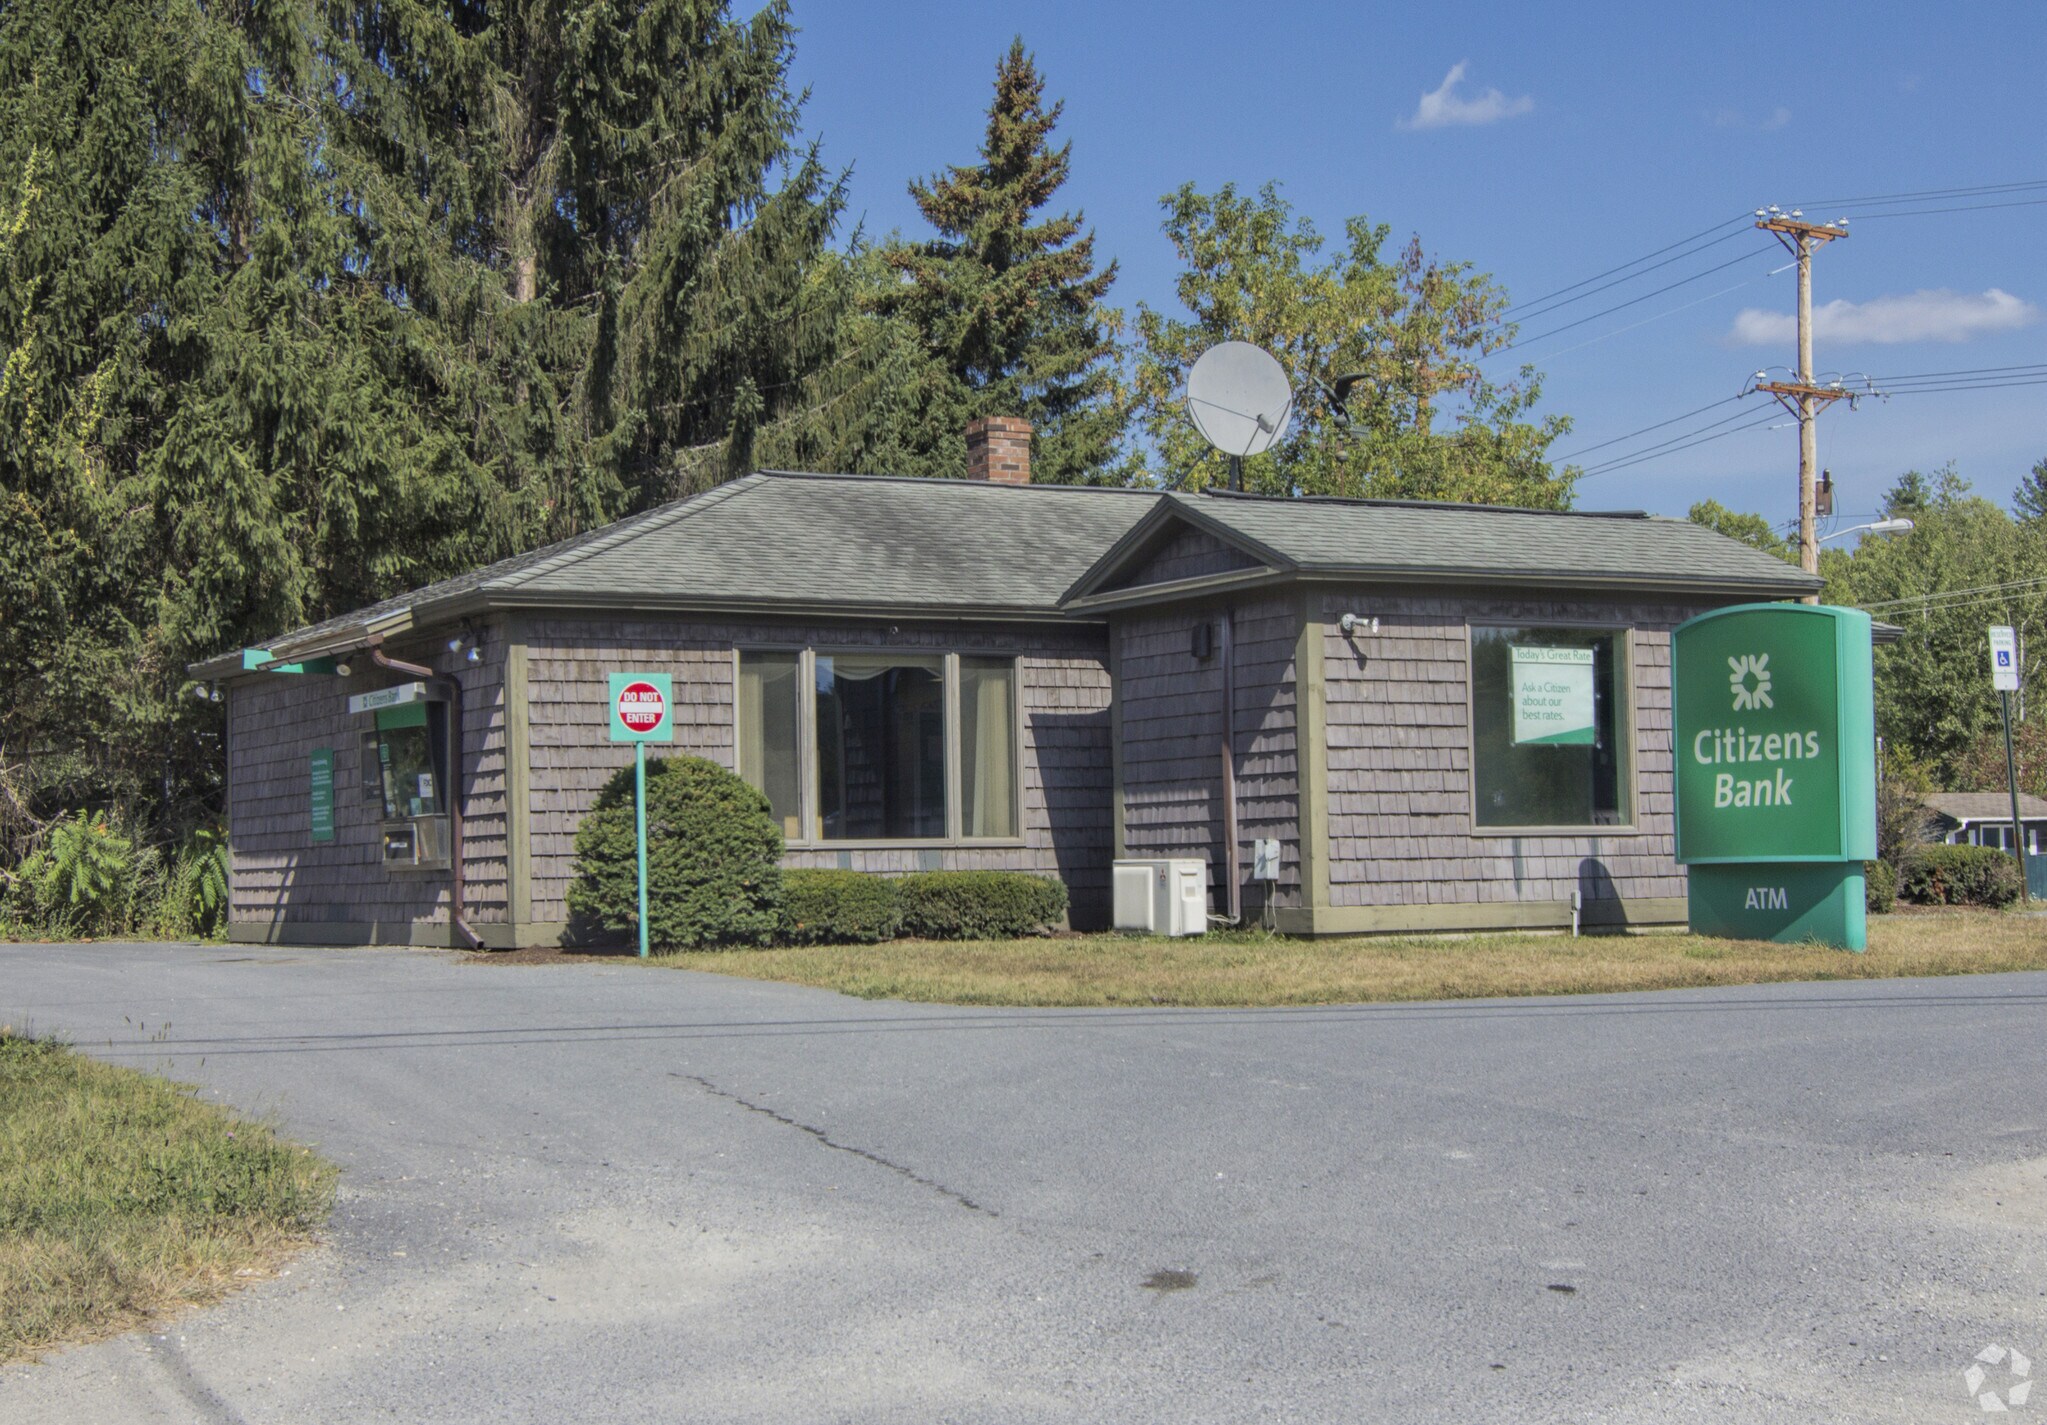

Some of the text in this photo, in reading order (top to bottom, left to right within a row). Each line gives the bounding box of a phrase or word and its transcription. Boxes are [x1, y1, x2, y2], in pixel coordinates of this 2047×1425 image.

[1516, 648, 1591, 661] Today's Great Rate
[1522, 682, 1536, 692] Ask
[1544, 682, 1571, 693] Citizen
[623, 692, 658, 702] DO NOT
[1522, 694, 1562, 707] about our
[626, 713, 656, 723] ENTER
[1522, 708, 1565, 720] best rates.
[1694, 727, 1820, 764] Citizens
[1714, 768, 1793, 808] Bank
[1745, 887, 1788, 910] ATM
